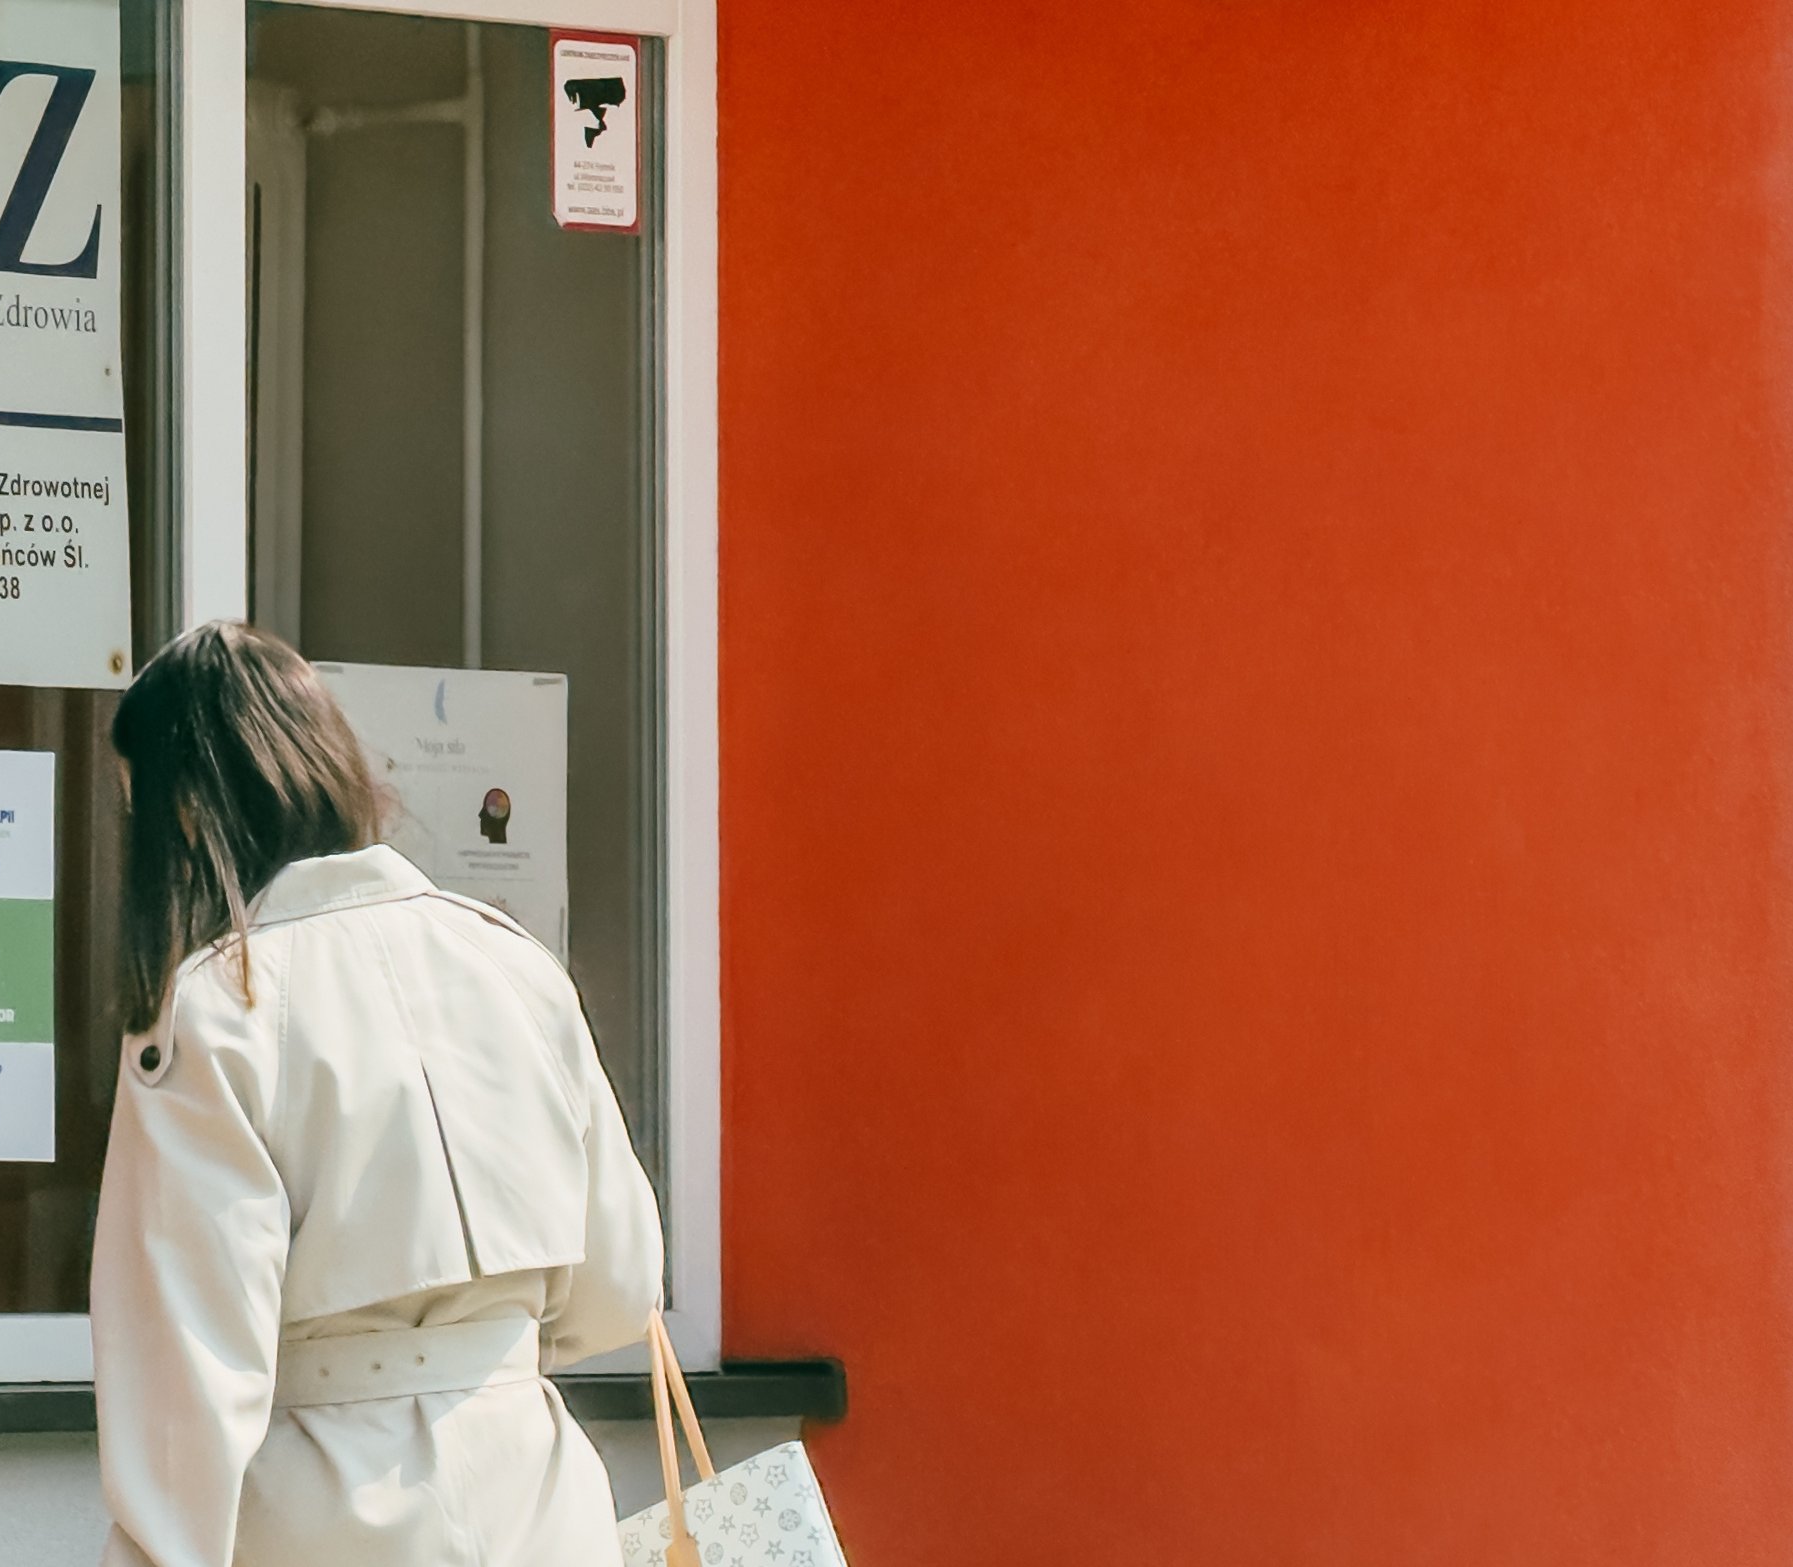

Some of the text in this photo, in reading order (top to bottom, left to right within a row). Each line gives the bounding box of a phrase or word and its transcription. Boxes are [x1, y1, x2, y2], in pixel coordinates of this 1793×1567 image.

[23, 513, 35, 532] z
[41, 514, 79, 534] o.o.
[63, 539, 90, 569] Śl.
